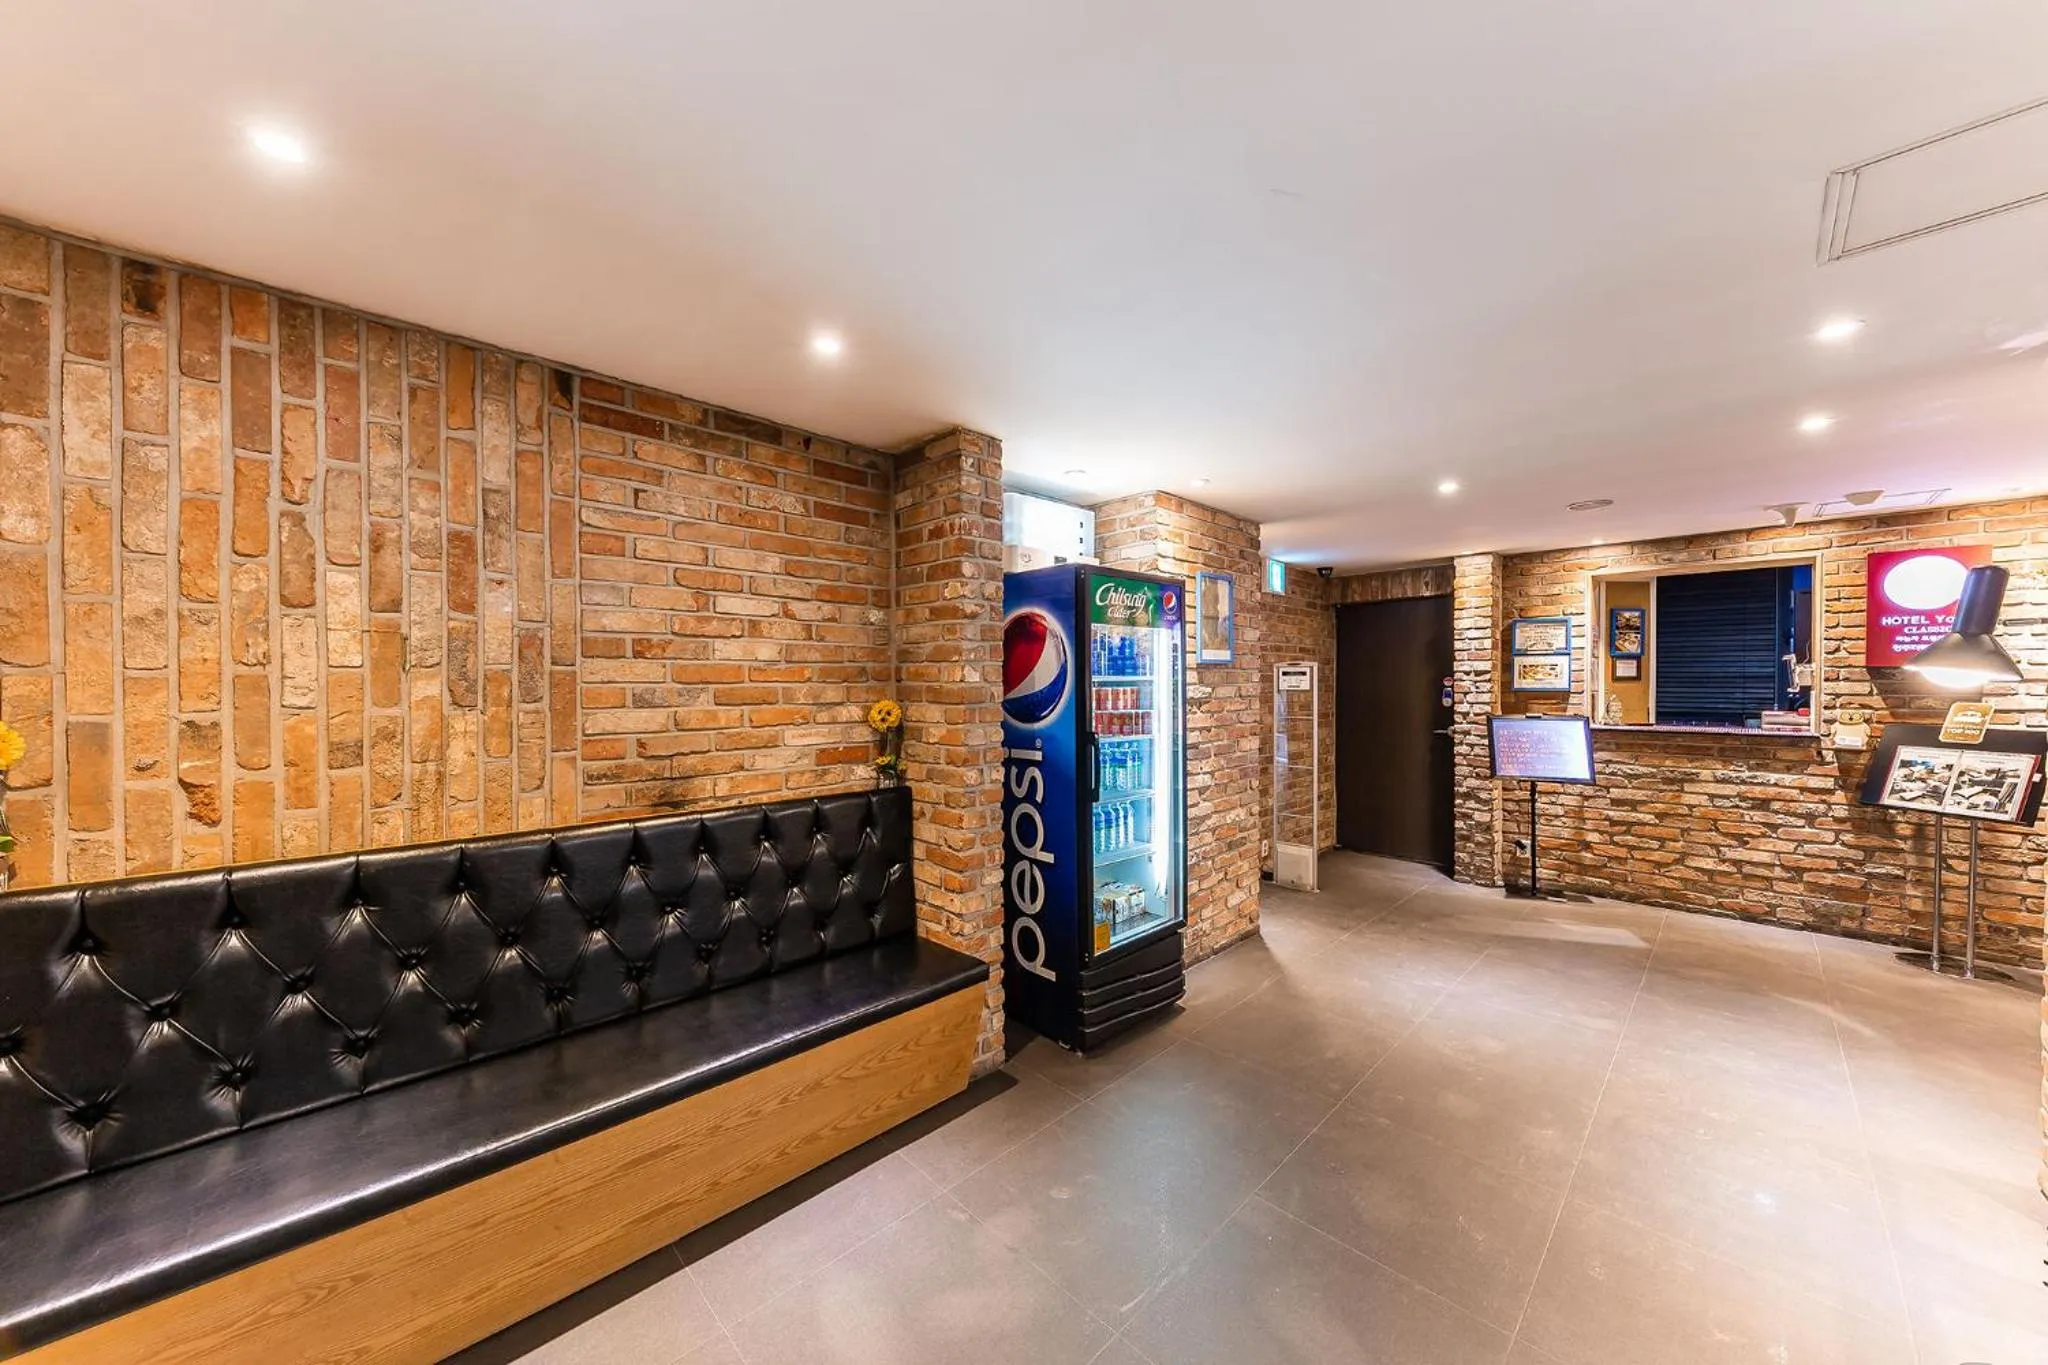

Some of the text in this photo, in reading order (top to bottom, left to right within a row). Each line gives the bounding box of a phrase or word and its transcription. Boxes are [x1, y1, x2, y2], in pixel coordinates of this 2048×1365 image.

[1881, 615, 1955, 626] HOTEL YO
[1004, 749, 1056, 982] pepsi
